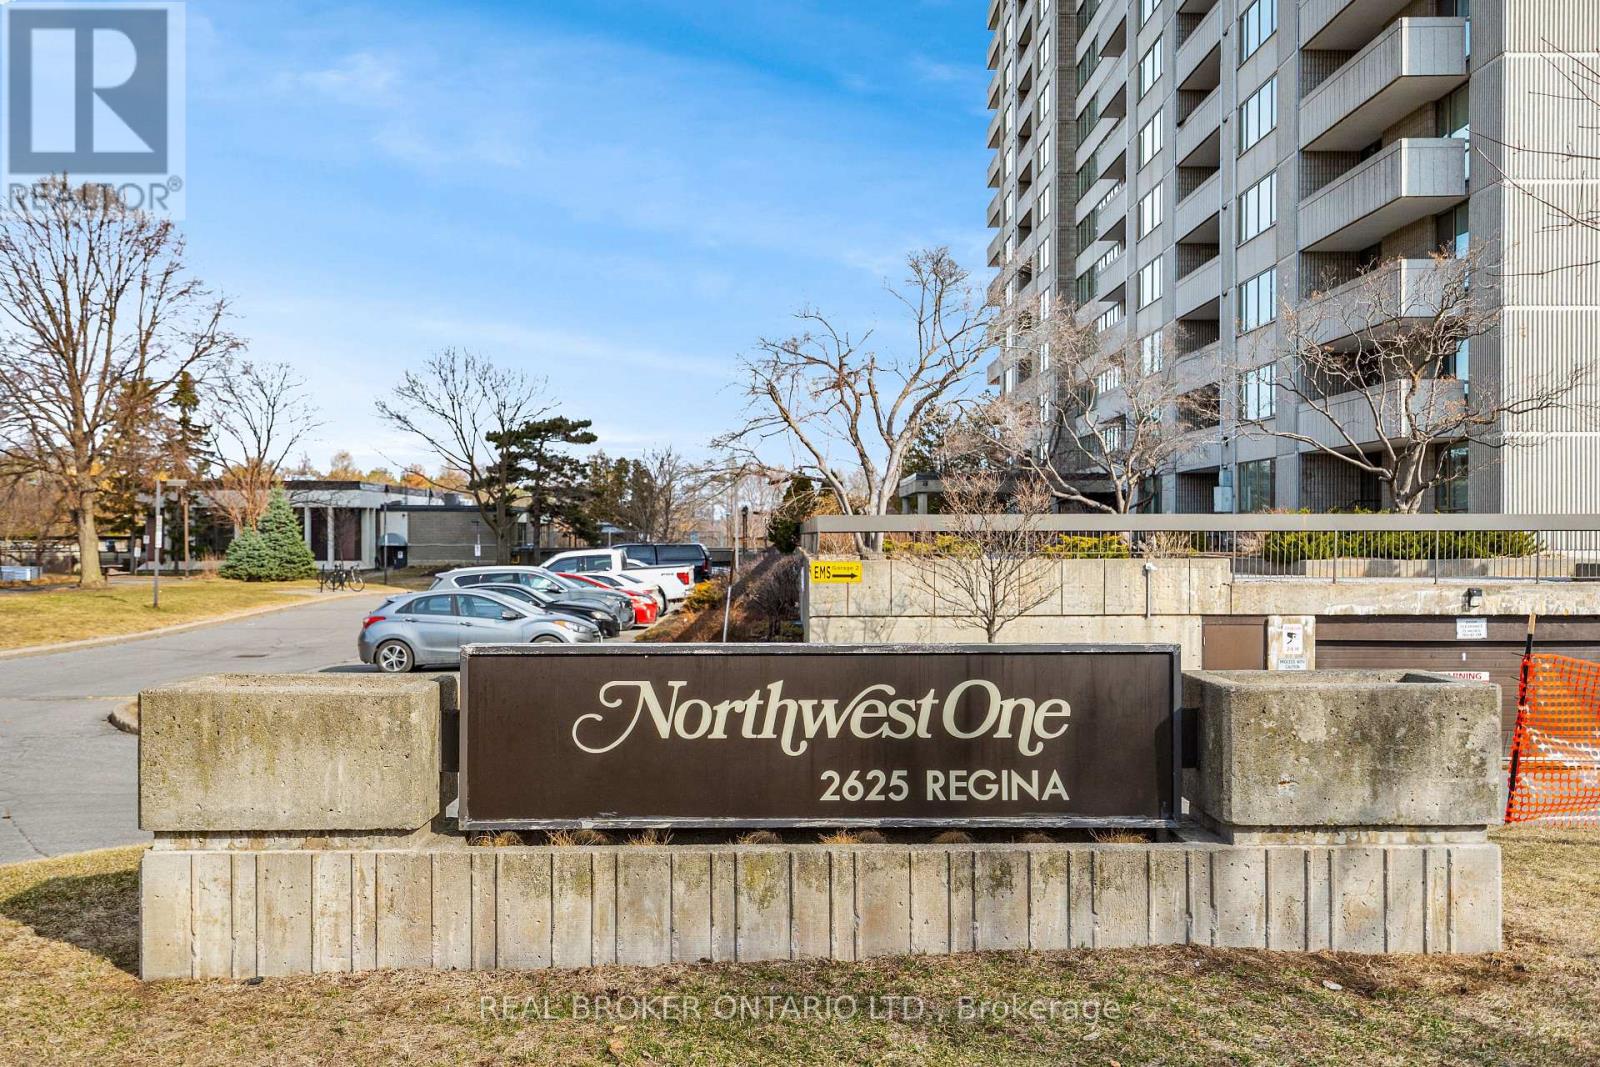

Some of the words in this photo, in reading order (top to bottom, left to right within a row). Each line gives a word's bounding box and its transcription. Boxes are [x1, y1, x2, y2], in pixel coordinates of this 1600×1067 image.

[814, 566, 831, 579] EMS
[1461, 652, 1467, 661] 1
[819, 769, 909, 802] 2625
[926, 769, 1070, 802] REGINA
